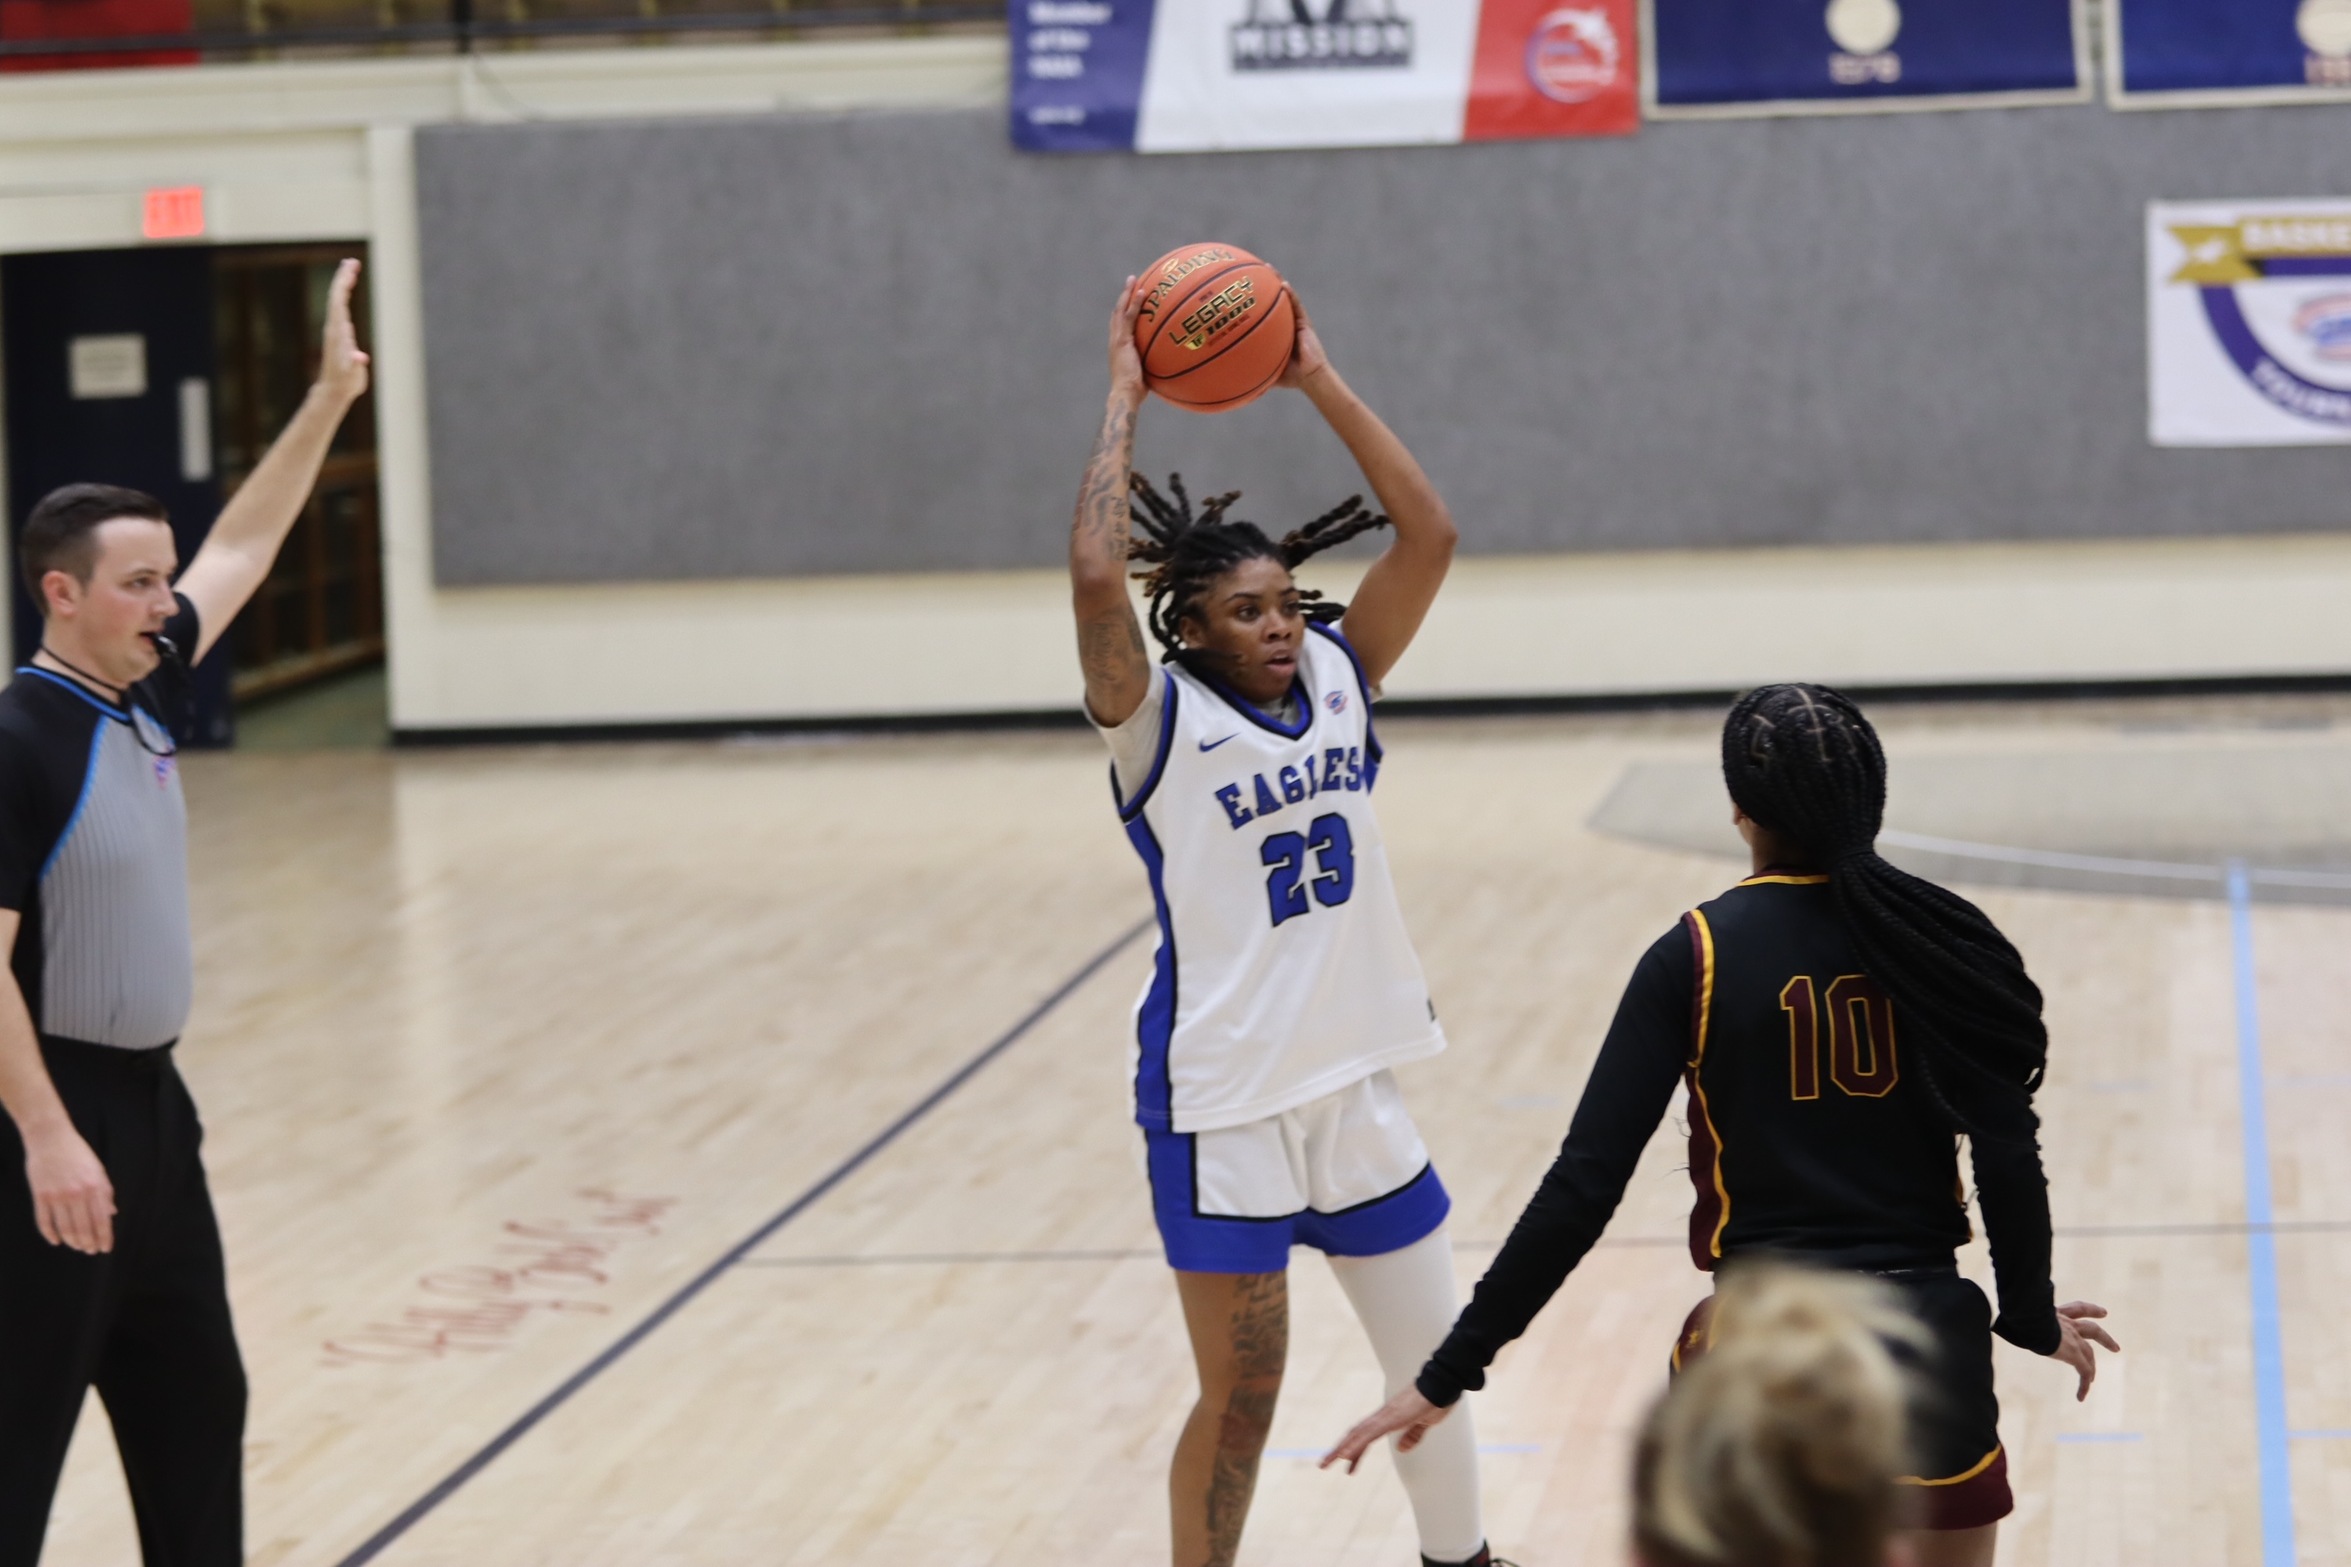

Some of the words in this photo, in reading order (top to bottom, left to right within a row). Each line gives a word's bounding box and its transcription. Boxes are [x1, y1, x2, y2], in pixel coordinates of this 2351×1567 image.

[1231, 24, 1410, 65] MISSION
[1139, 249, 1237, 322] SPALDING
[1168, 276, 1254, 345] LEGACY
[1207, 297, 1255, 336] 1000
[1214, 746, 1363, 830] EAGLES
[1260, 812, 1354, 928] 23
[1779, 975, 1899, 1100] 10
